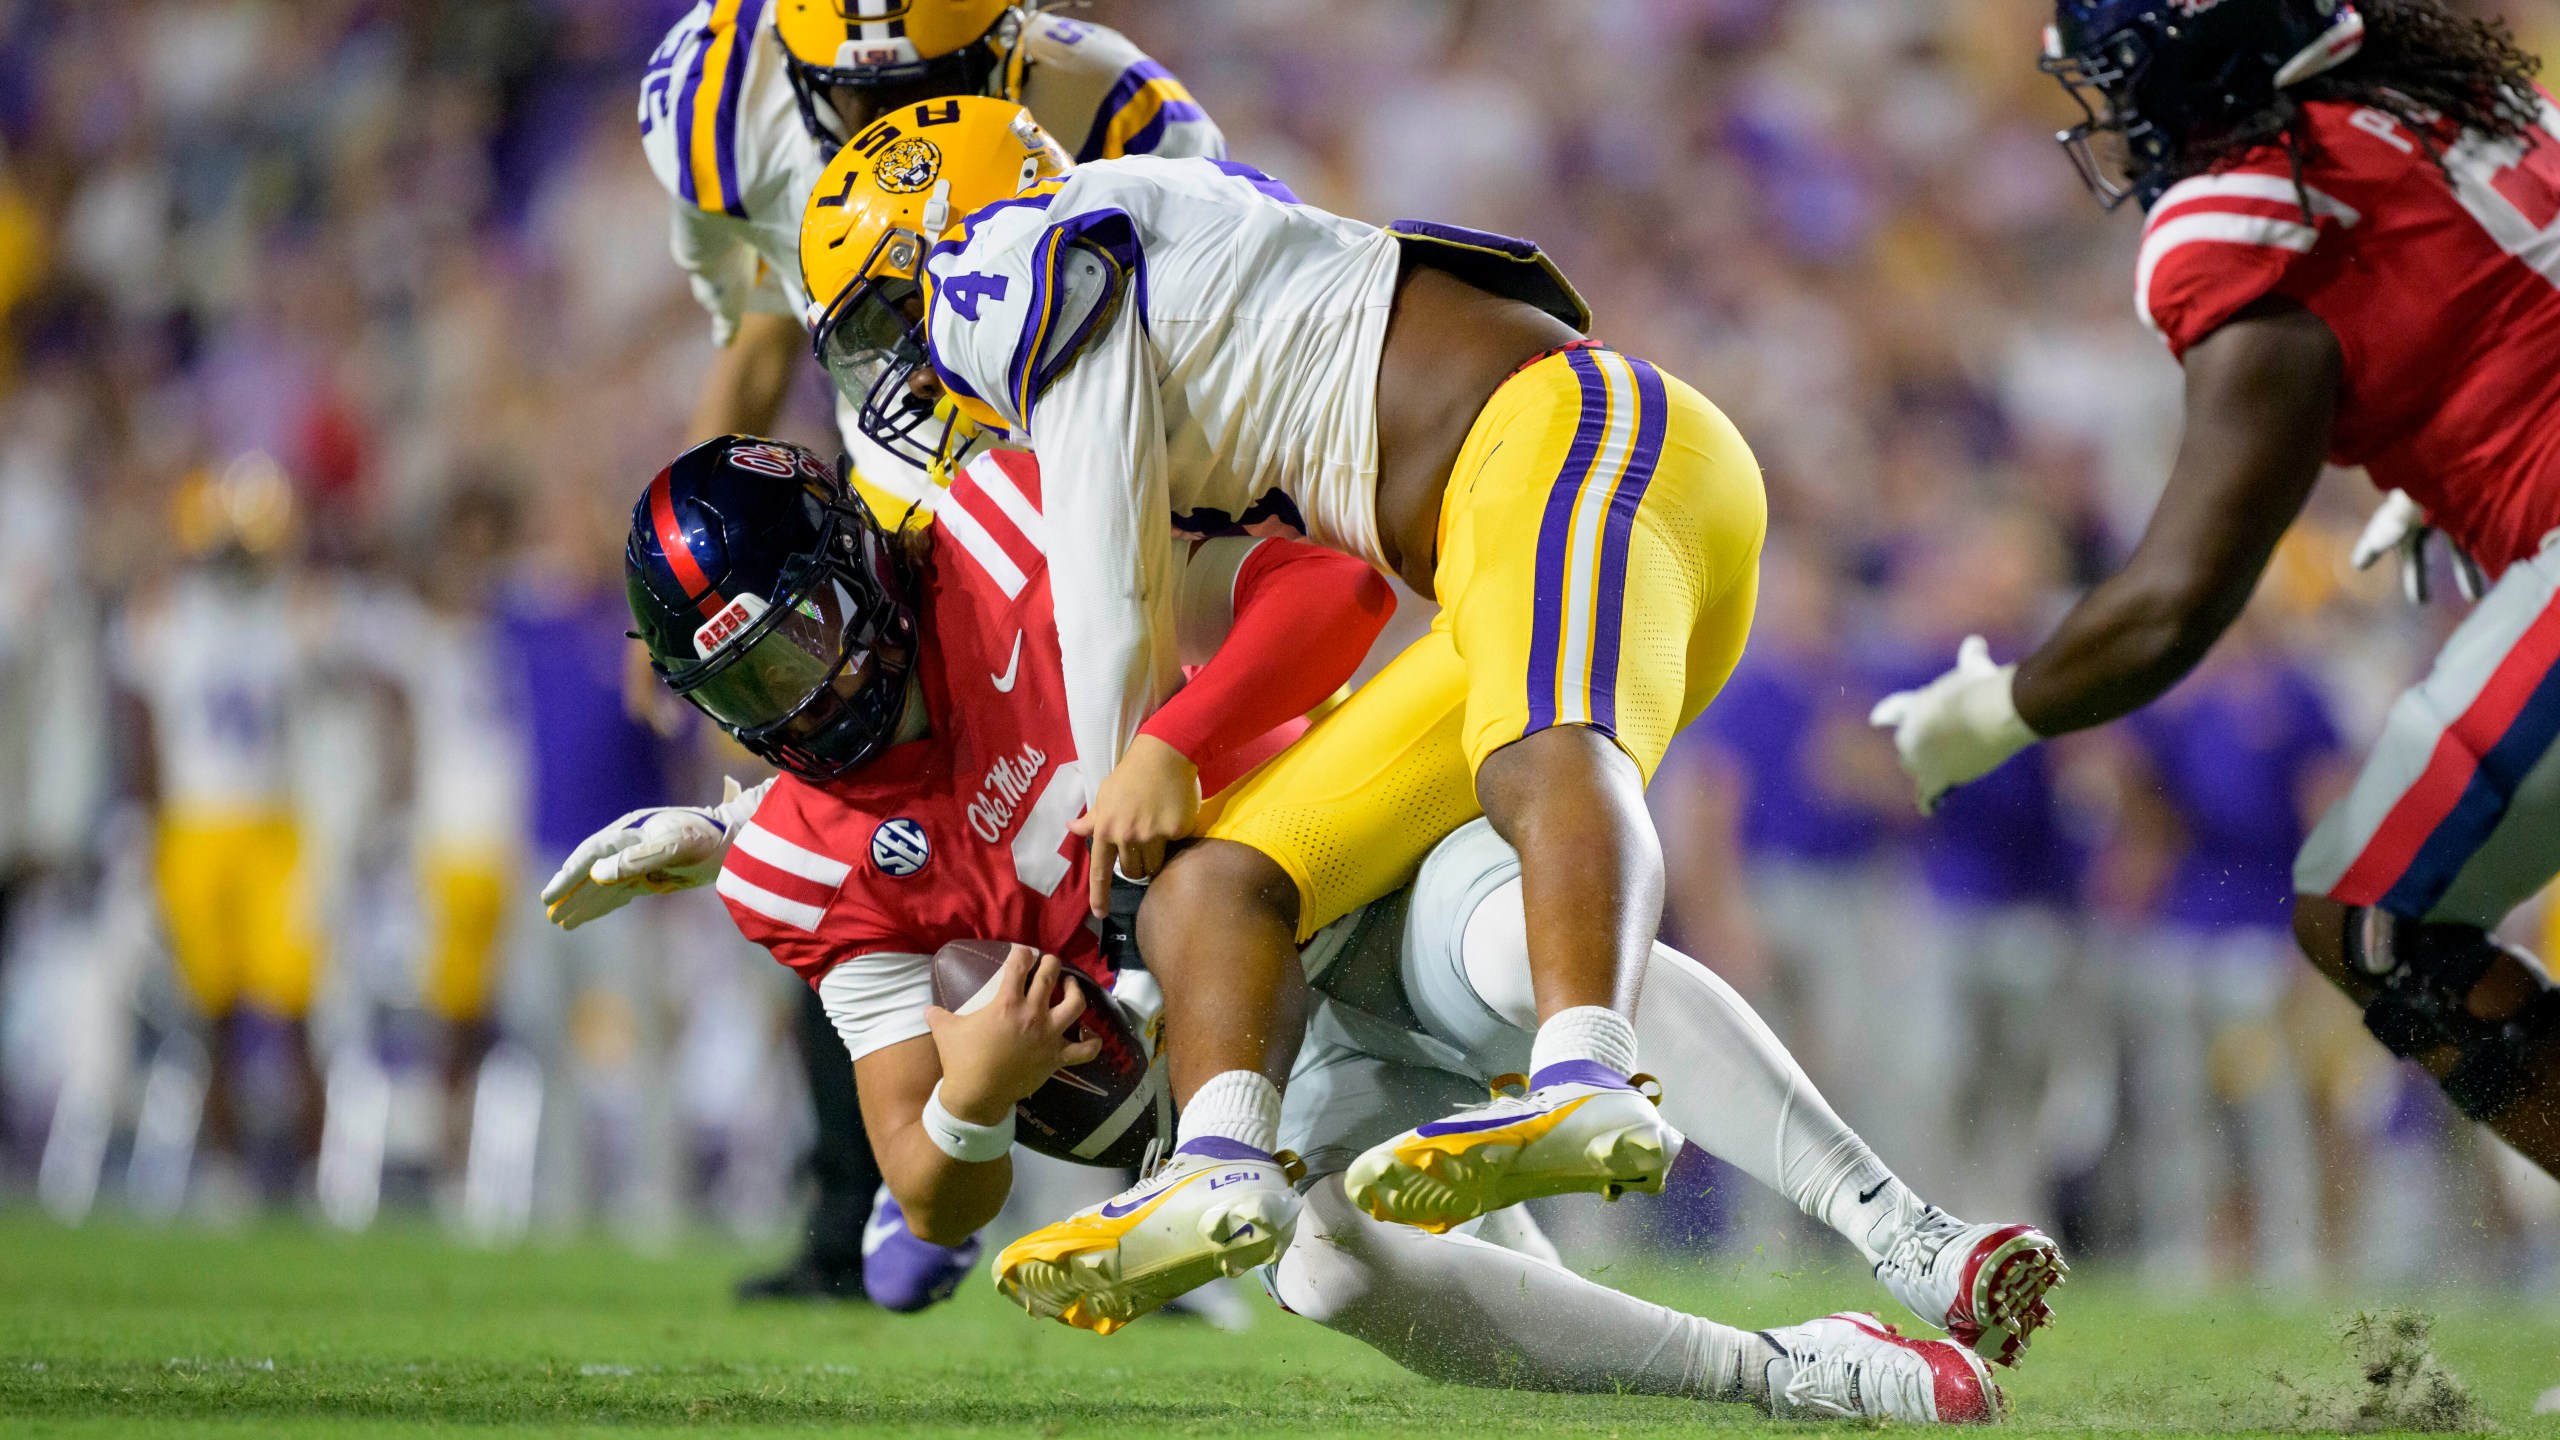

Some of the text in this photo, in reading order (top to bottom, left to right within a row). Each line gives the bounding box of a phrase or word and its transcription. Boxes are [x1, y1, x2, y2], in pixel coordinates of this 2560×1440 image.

[816, 99, 960, 208] LSU
[942, 270, 1010, 322] 4
[697, 603, 749, 651] REBS
[967, 743, 1046, 844] Ole Miss
[872, 819, 929, 875] SEC
[1210, 1172, 1260, 1190] LSU
